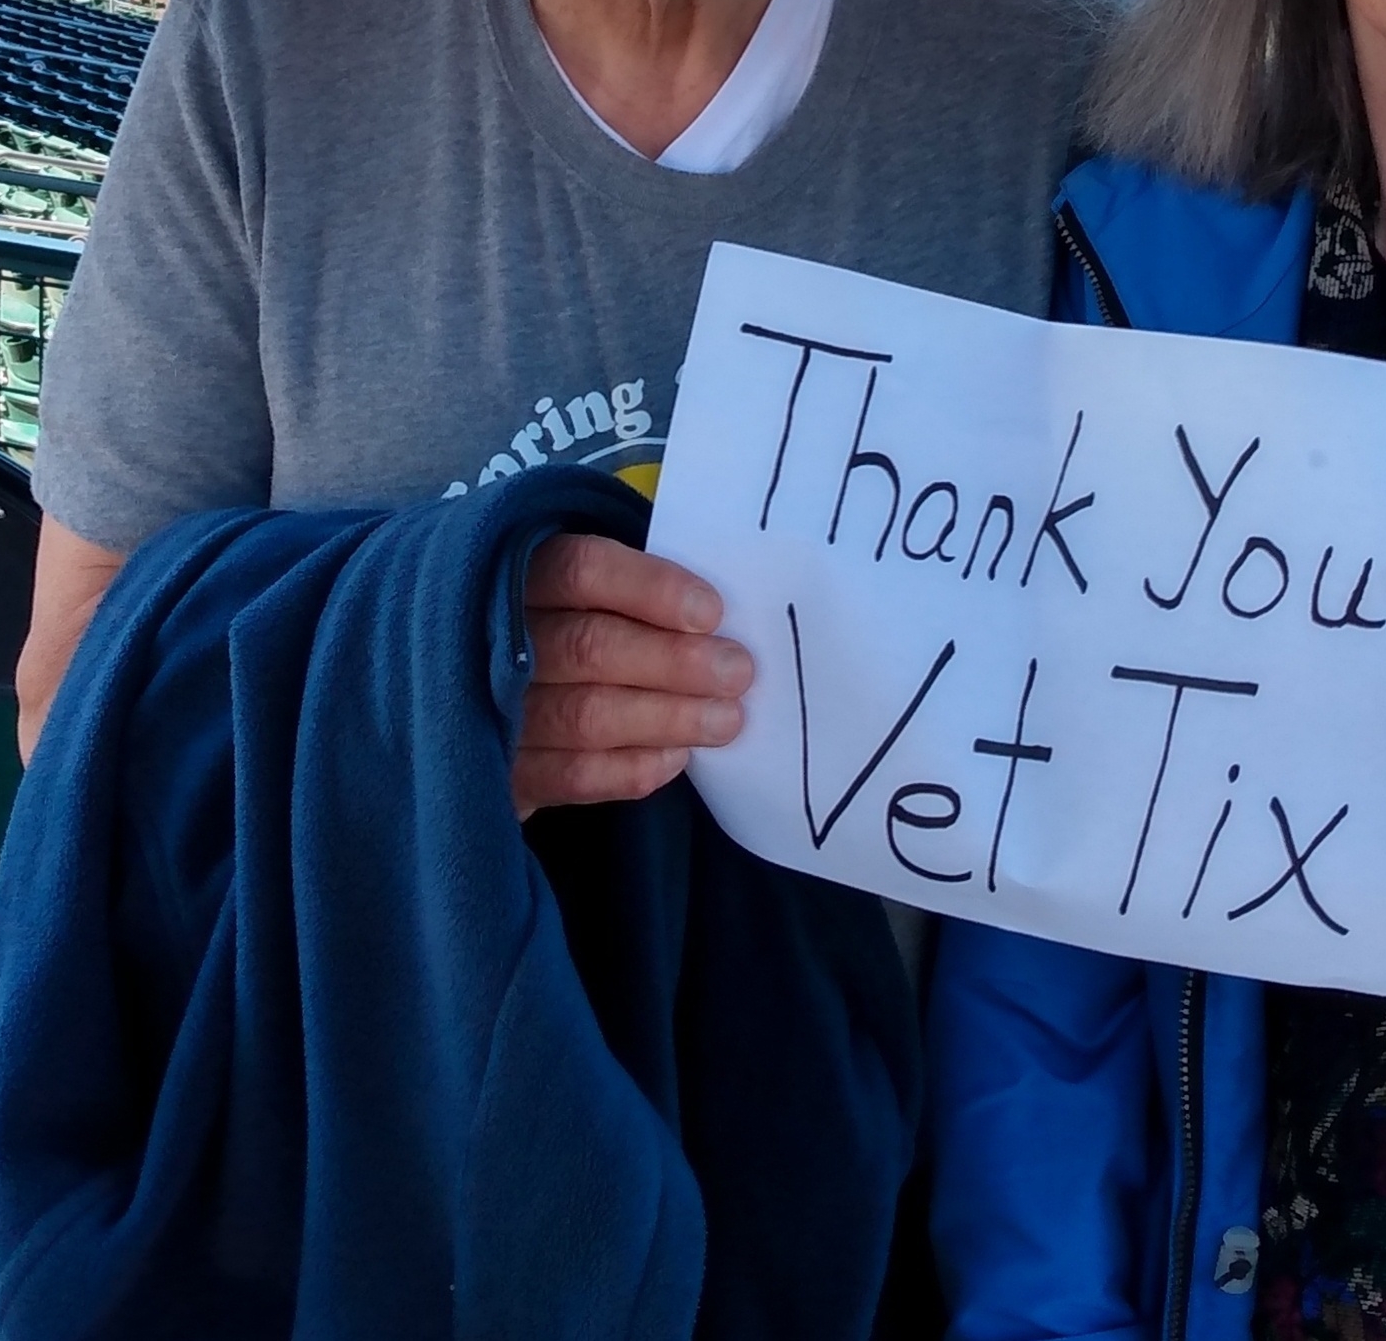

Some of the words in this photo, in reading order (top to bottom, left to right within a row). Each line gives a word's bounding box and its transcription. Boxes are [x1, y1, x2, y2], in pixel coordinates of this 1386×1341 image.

[739, 322, 1095, 594] Thank
[1144, 424, 1386, 629] You
[787, 603, 1053, 892] Vet
[1110, 666, 1350, 936] Tix
